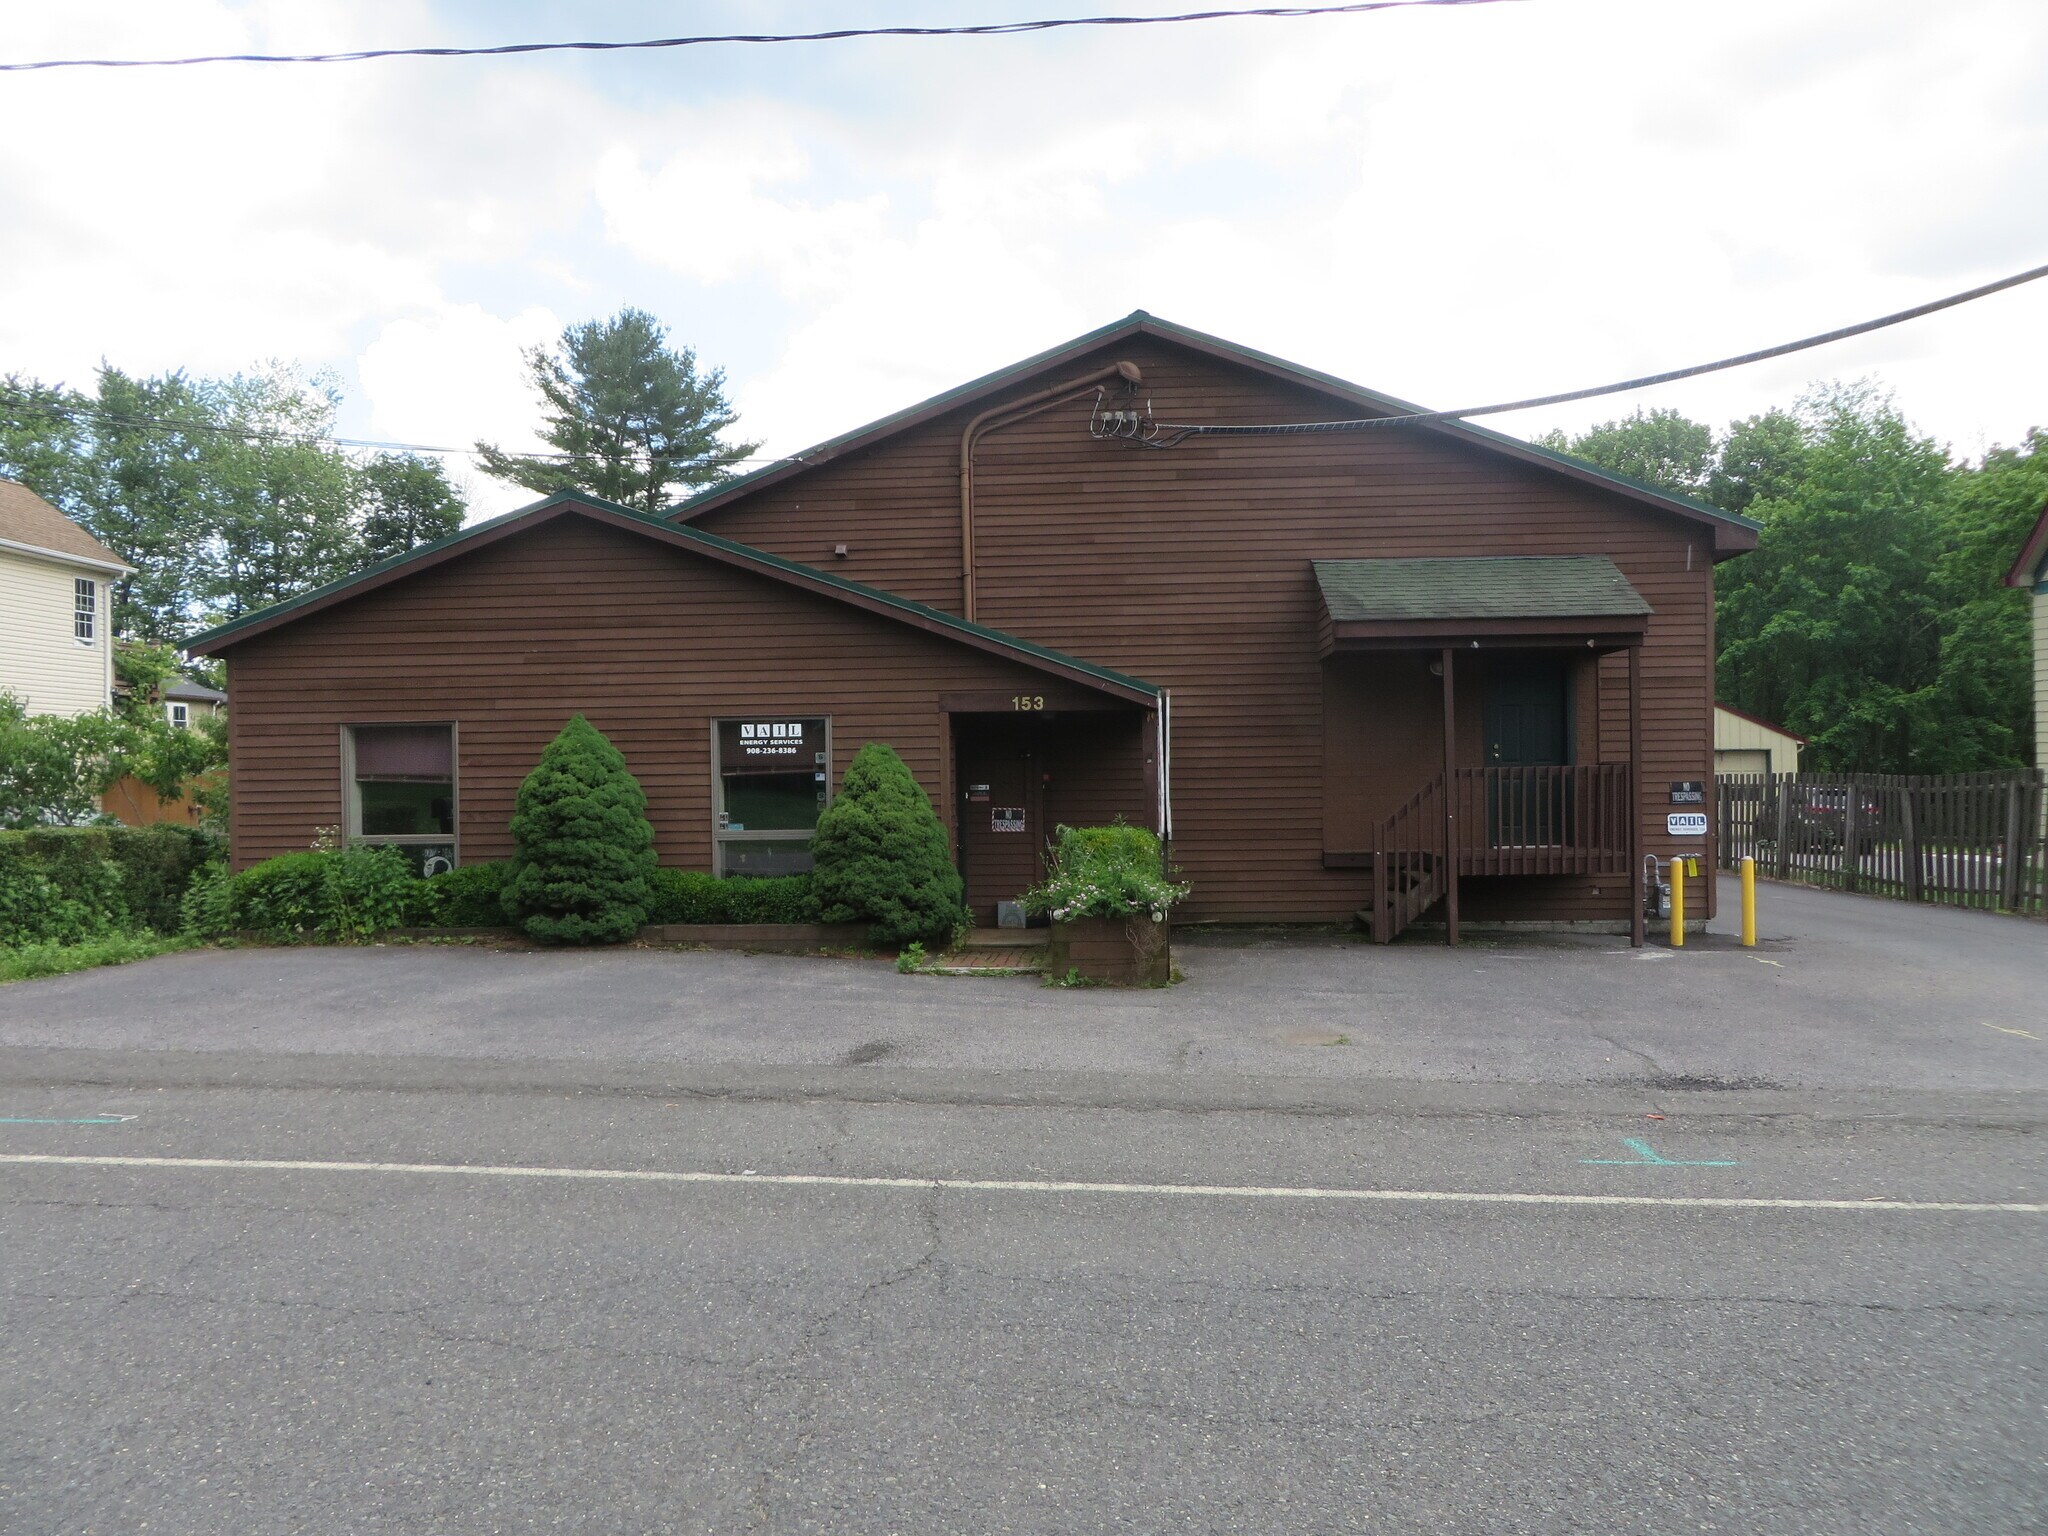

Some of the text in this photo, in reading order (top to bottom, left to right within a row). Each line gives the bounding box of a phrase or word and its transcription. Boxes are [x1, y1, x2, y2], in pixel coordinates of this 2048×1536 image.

[1012, 696, 1044, 711] 153
[743, 725, 800, 736] VAIL
[1670, 817, 1704, 825] VAIL
